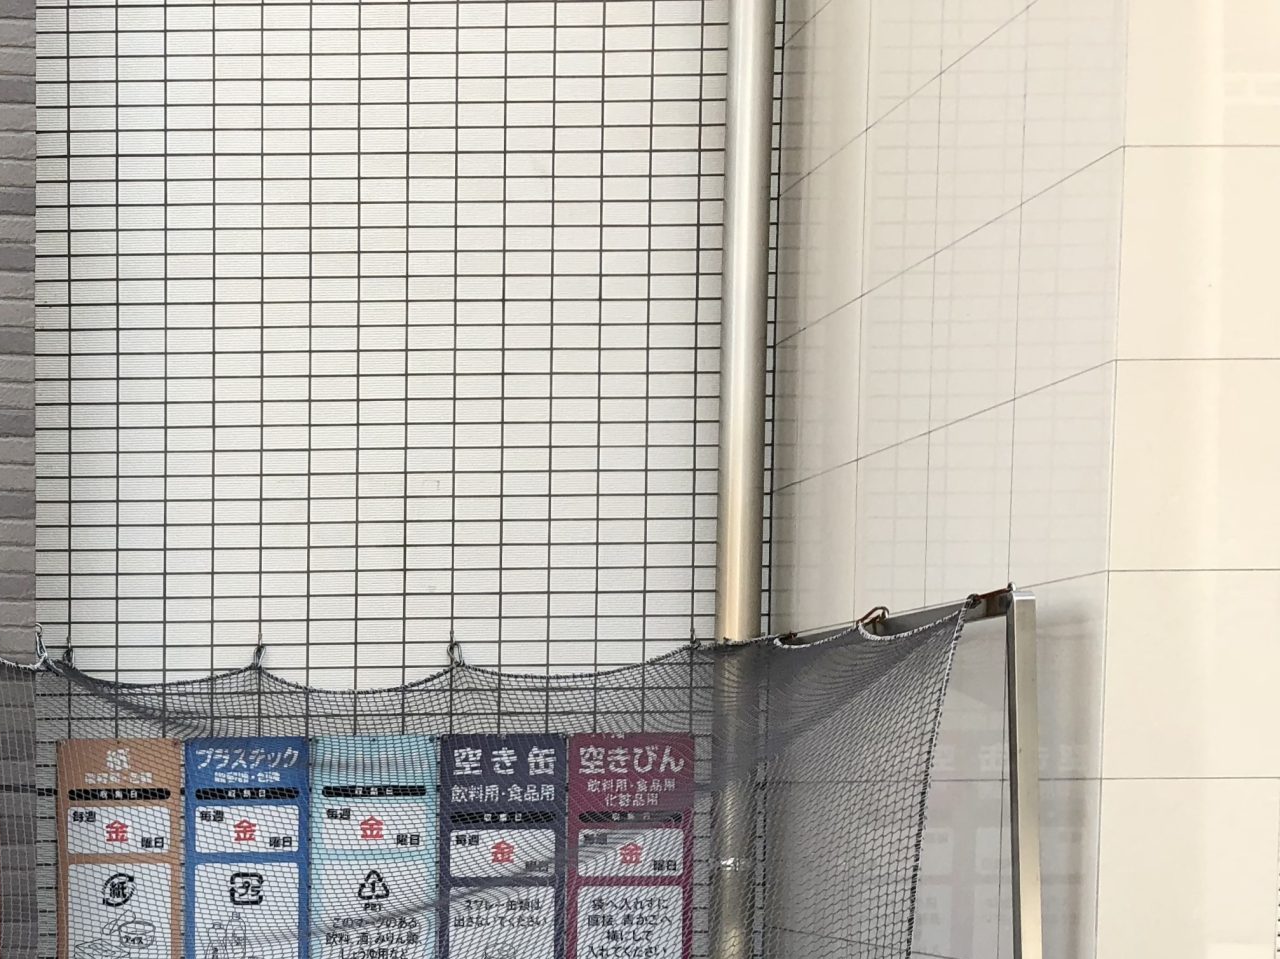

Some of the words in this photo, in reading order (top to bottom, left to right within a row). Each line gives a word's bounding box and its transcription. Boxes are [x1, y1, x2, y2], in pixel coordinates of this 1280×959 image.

[195, 747, 299, 769] プラスチック
[453, 746, 556, 775] 空き缶
[579, 744, 685, 775] 空きびん
[451, 784, 555, 802] 飲料用・食品用
[106, 820, 129, 843] 金
[141, 837, 164, 848] 曜日
[233, 819, 257, 842] 金
[269, 837, 292, 848] 曜日
[360, 815, 384, 839] 金
[396, 833, 420, 846] 曜日
[491, 839, 514, 864] 金
[619, 841, 643, 865] 金
